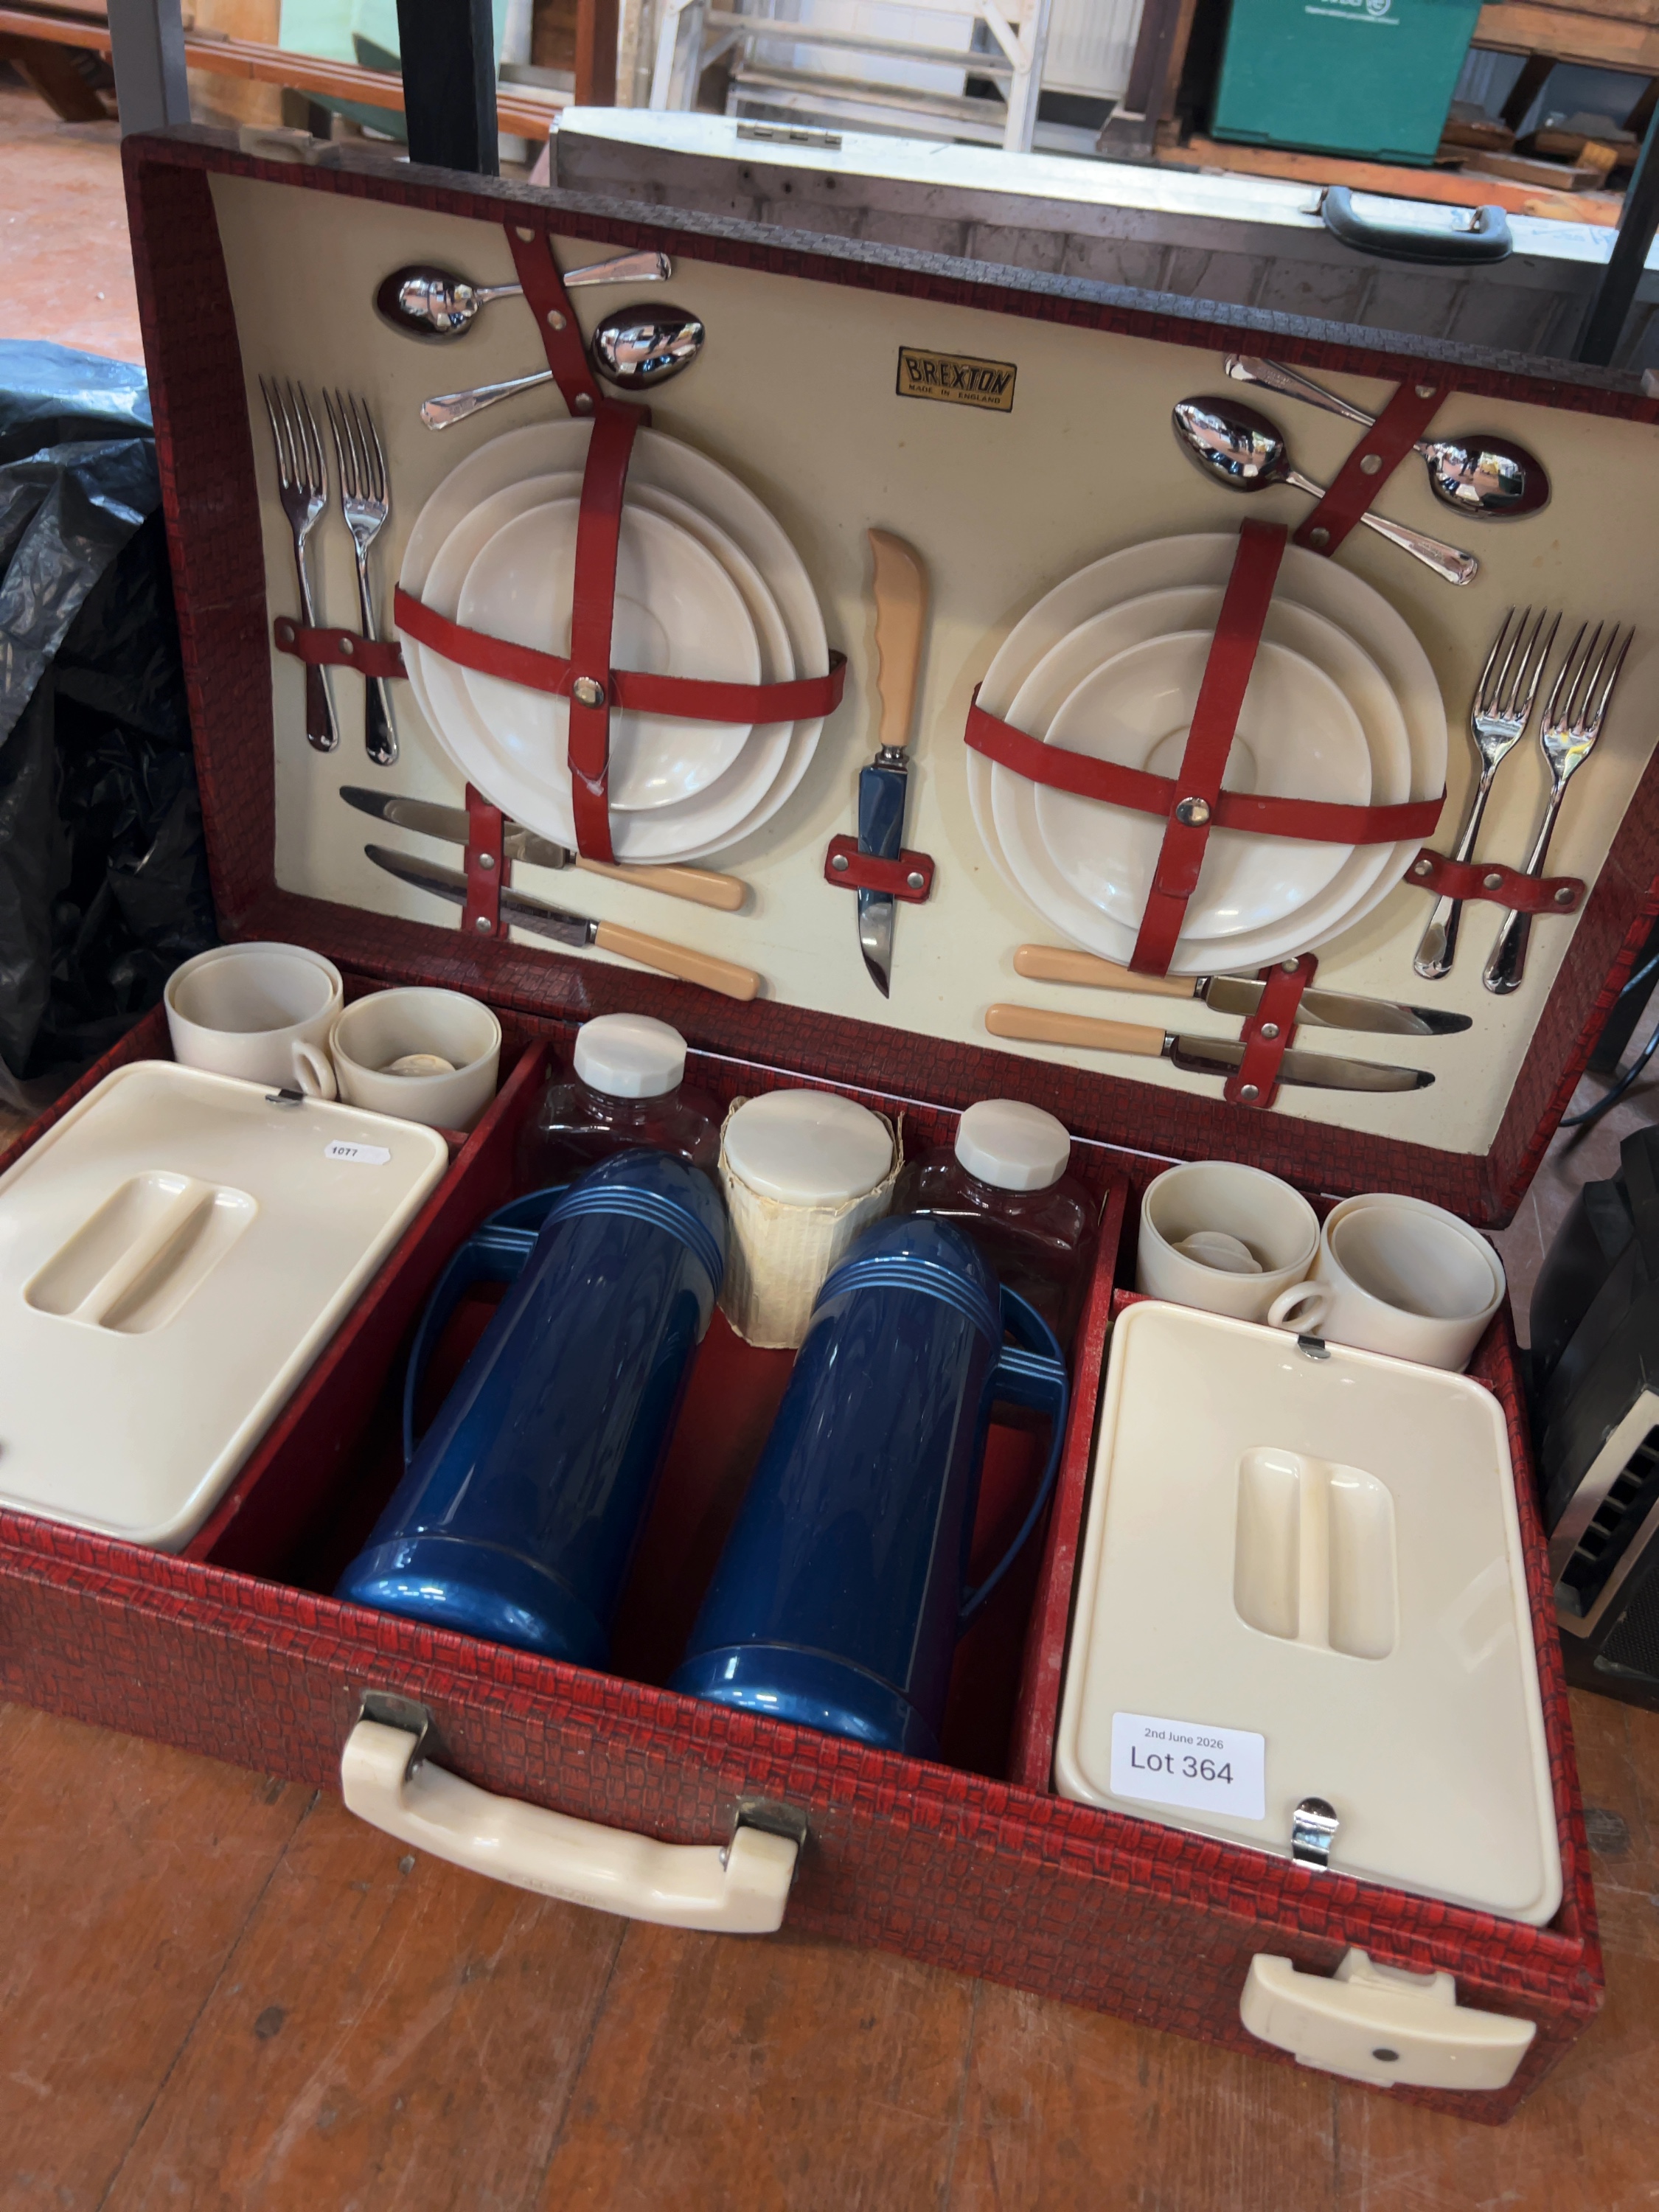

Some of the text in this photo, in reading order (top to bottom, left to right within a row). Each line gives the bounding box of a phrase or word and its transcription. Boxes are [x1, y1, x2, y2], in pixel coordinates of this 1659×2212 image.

[904, 356, 1012, 395] BREXTON
[908, 383, 1001, 404] MADE IN ENGLAND
[333, 1146, 358, 1157] 1077
[1144, 1728, 1225, 1750] 2nd June 2026
[1130, 1745, 1234, 1784] Lot 364
